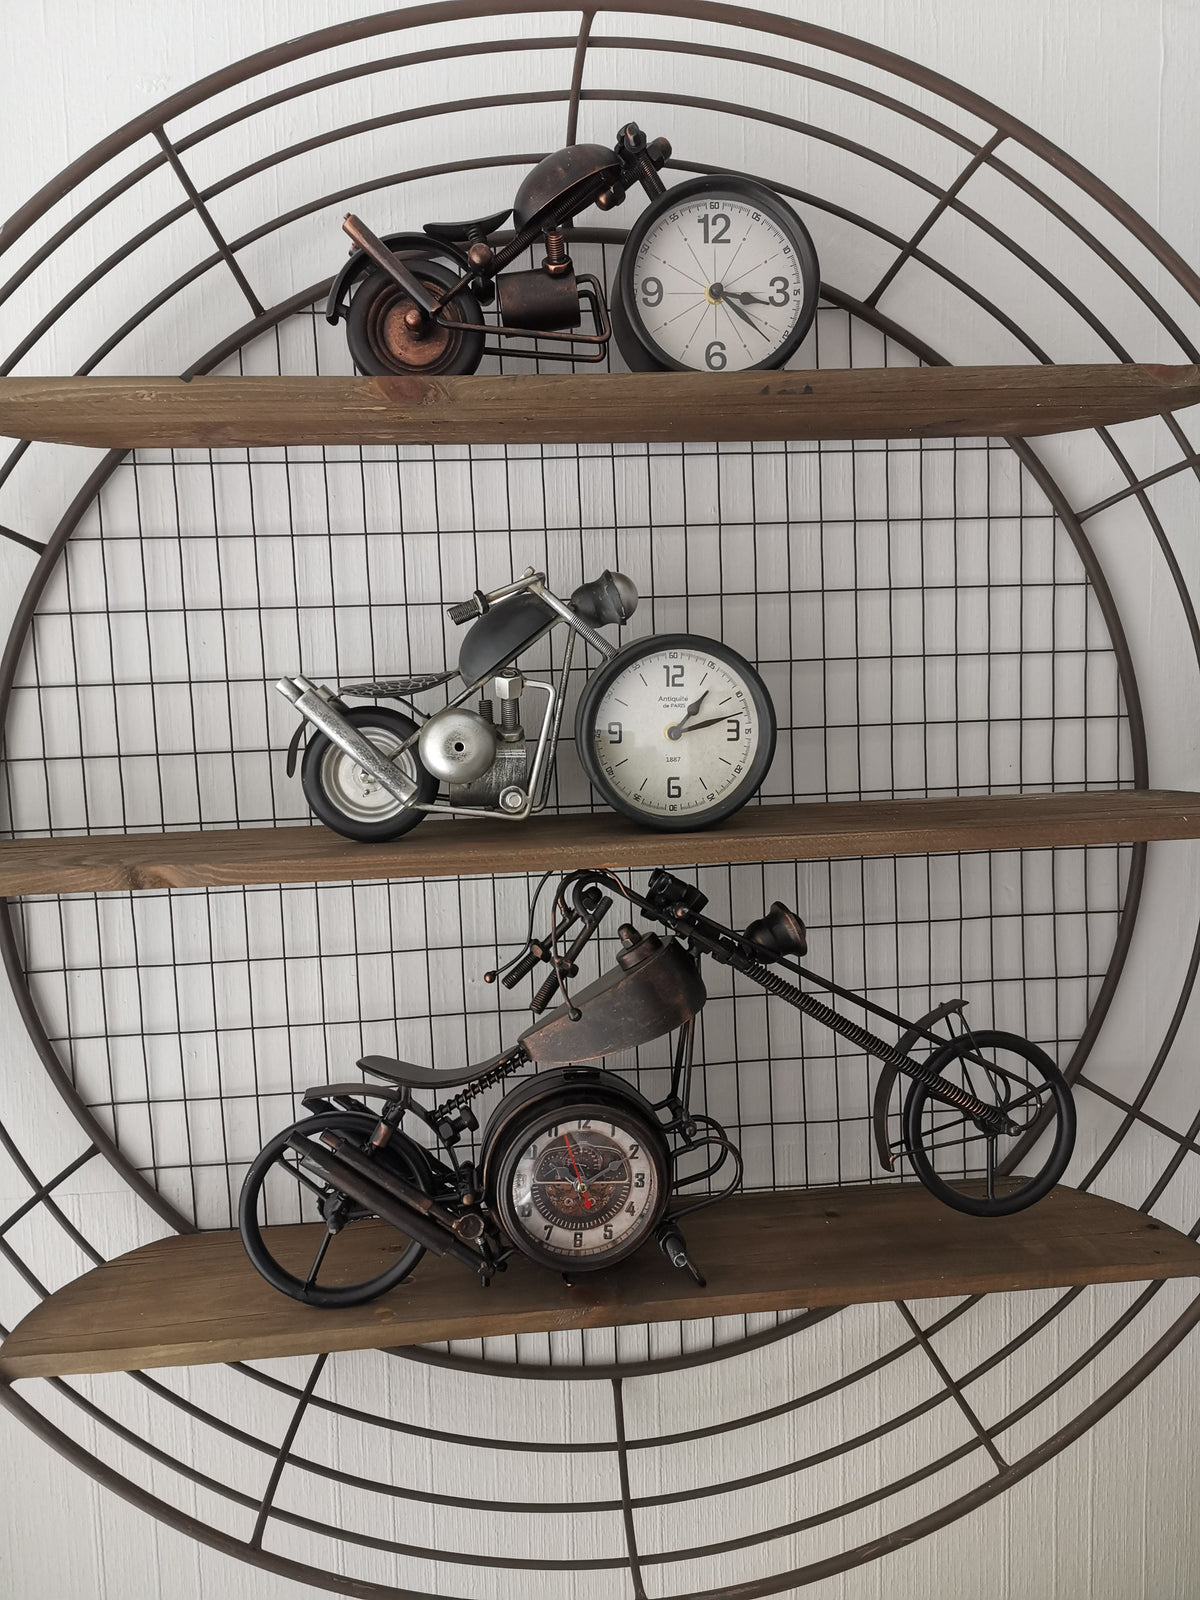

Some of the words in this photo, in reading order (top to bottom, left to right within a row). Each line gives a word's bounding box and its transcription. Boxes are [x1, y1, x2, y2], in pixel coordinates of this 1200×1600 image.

[709, 202, 720, 210] 60
[669, 213, 680, 223] 55
[751, 212, 762, 222] 05
[697, 213, 731, 244] 12
[640, 243, 650, 254] 50
[782, 244, 792, 255] 10
[641, 276, 664, 308] 9
[768, 276, 790, 308] 3
[704, 341, 727, 371] 6
[707, 661, 716, 670] 05
[662, 664, 684, 688] 12
[608, 721, 622, 744] 9
[726, 719, 740, 742] 3
[667, 777, 682, 799] 6
[629, 1144, 640, 1160] 2
[634, 1173, 645, 1188] 3
[625, 1201, 636, 1217] 4
[543, 1224, 554, 1241] 7
[573, 1232, 583, 1248] 6
[603, 1224, 614, 1240] 5
